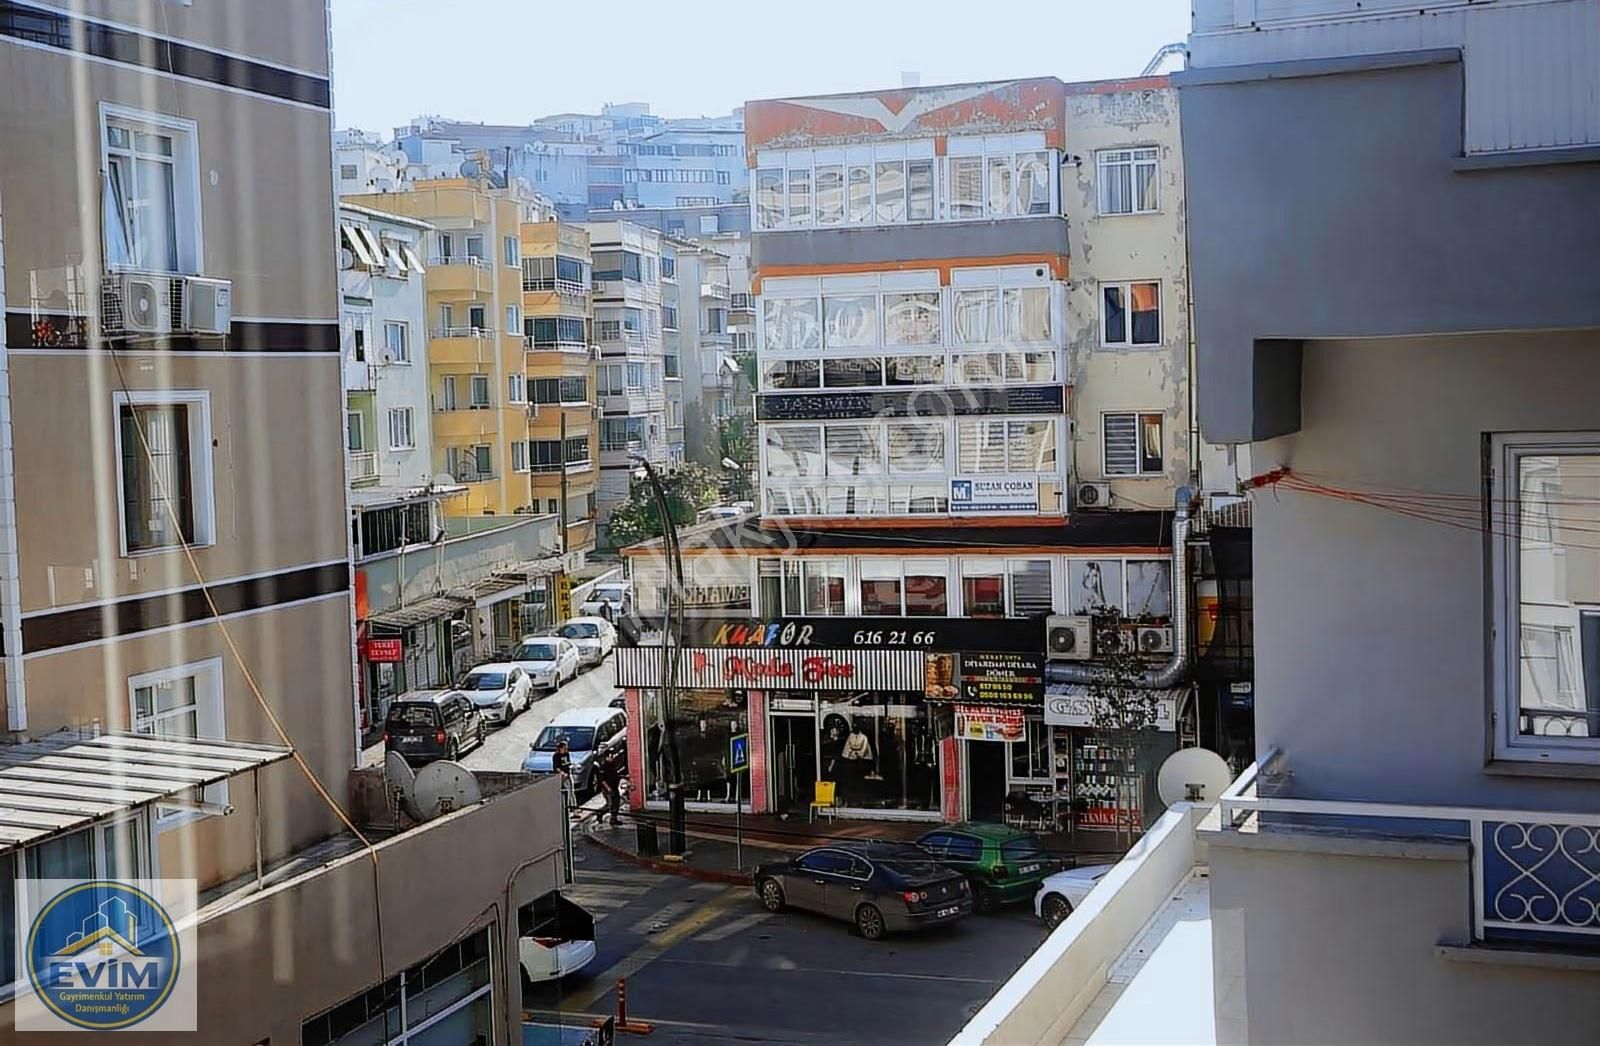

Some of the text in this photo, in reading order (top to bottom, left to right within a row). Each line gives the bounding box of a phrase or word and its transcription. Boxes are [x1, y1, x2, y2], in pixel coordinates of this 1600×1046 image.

[854, 630, 936, 645] 616 21 66
